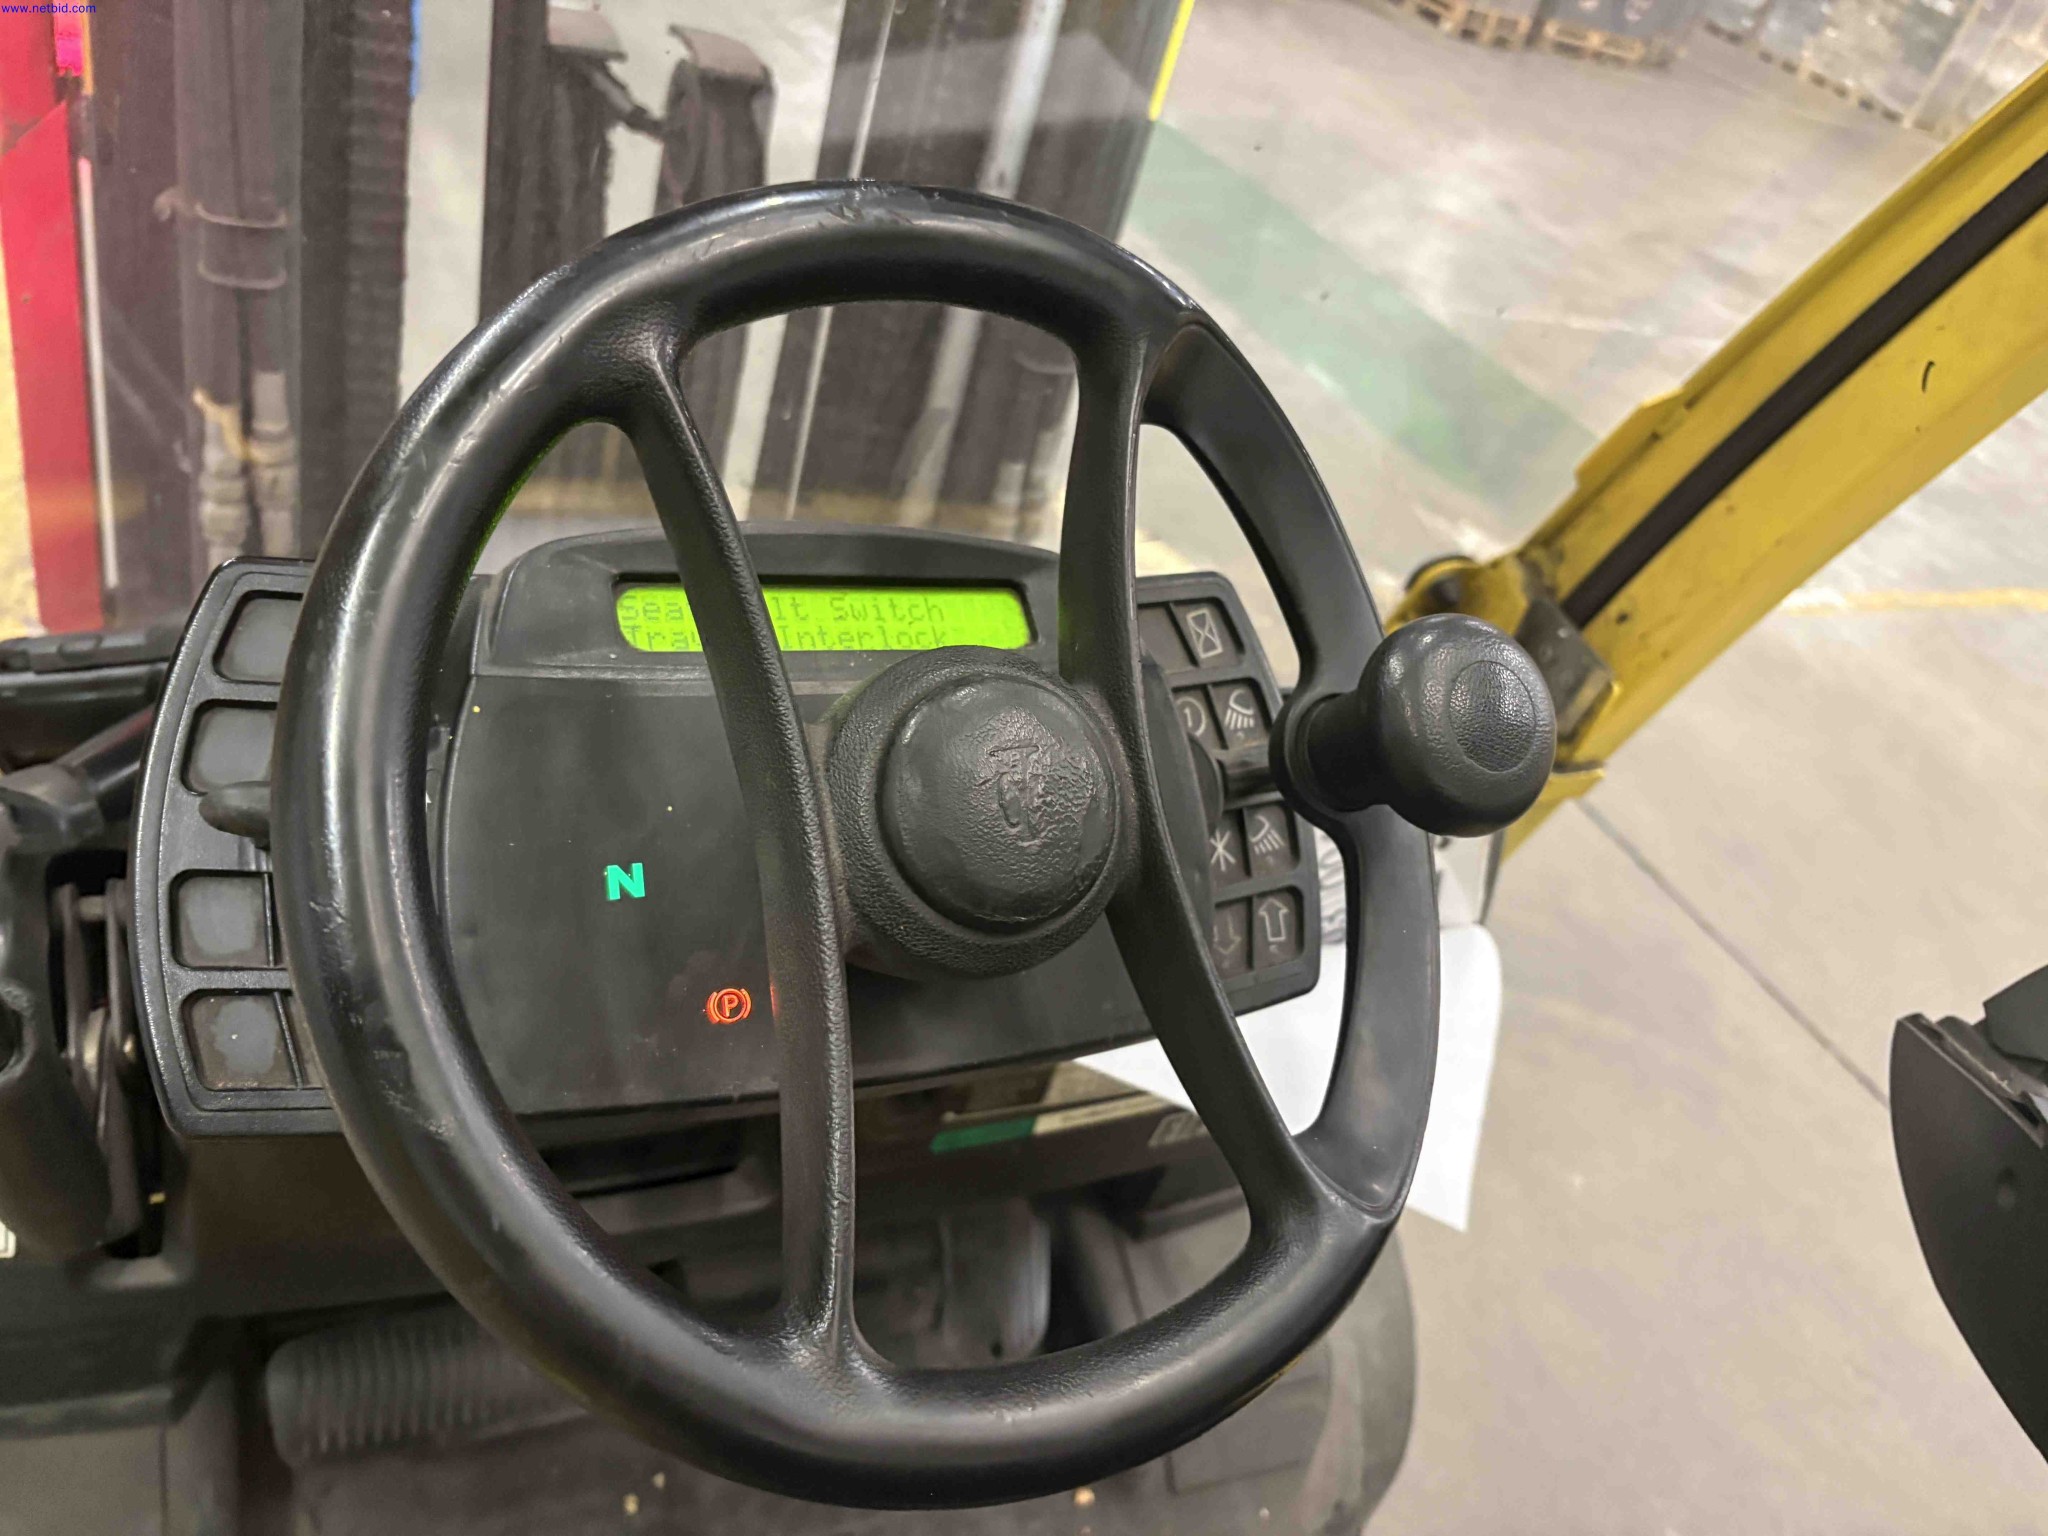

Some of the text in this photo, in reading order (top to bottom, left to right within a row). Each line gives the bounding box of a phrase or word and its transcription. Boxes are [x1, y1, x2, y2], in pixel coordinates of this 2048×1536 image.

[621, 594, 690, 621] Sea
[829, 595, 945, 622] Switch
[777, 624, 947, 650] Interlock
[606, 862, 646, 901] N
